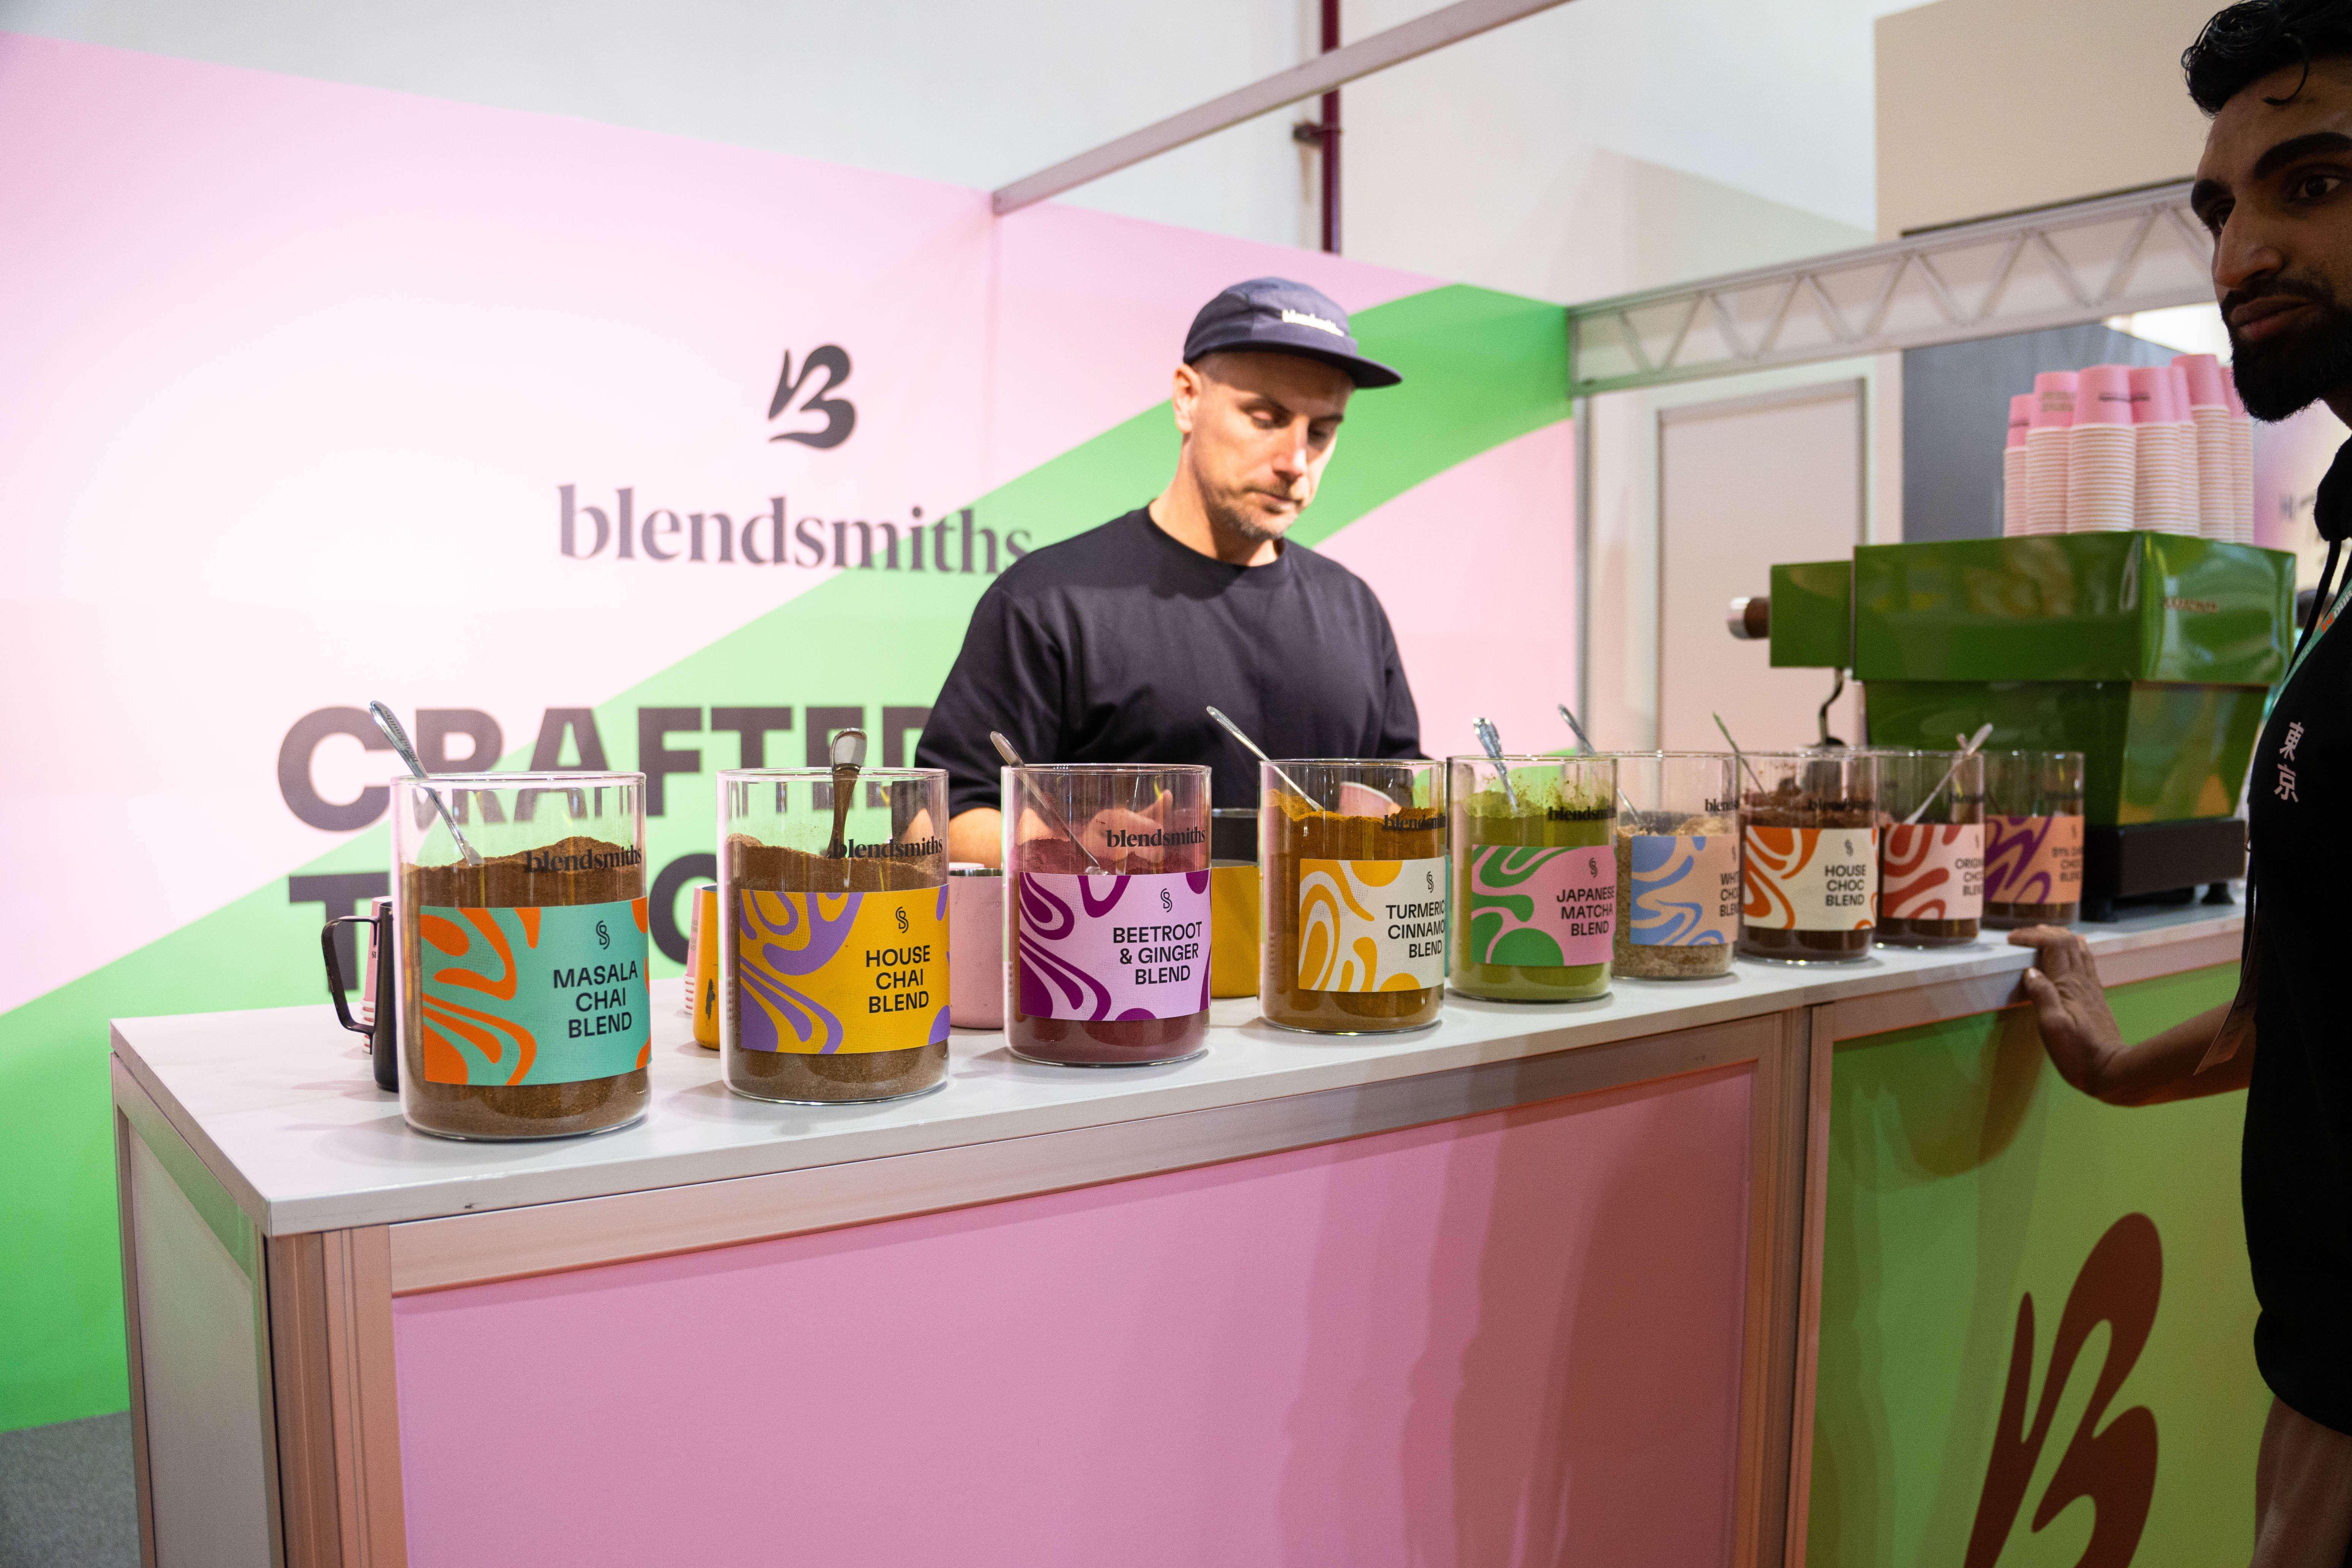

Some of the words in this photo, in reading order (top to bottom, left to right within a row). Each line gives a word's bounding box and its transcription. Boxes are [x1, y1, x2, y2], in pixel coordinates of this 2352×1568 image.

[557, 483, 1032, 575] blendsmiths
[2274, 721, 2305, 803] 東京
[832, 836, 943, 859] blendsmiths
[1106, 826, 1205, 847] blendsmiths
[526, 844, 642, 873] blendsmiths
[1825, 863, 1866, 877] HOUSE
[1556, 885, 1615, 903] JAPANESE
[1826, 879, 1864, 892] CHOC
[1825, 893, 1865, 906] BLEND
[1113, 921, 1202, 944] BEETROOT
[1388, 918, 1445, 939] CINNAMO
[1571, 920, 1609, 936] BLEND
[866, 945, 930, 967] HOUSE
[1120, 948, 1132, 964] &
[1138, 943, 1199, 964] GINGER
[1409, 940, 1442, 958] BLEND
[553, 960, 638, 988] MASALA
[876, 968, 923, 990] CHAI
[1135, 965, 1190, 985] BLEND
[576, 987, 626, 1012] CHAI
[869, 991, 929, 1013] BLEND
[569, 1012, 632, 1038] BLEND
